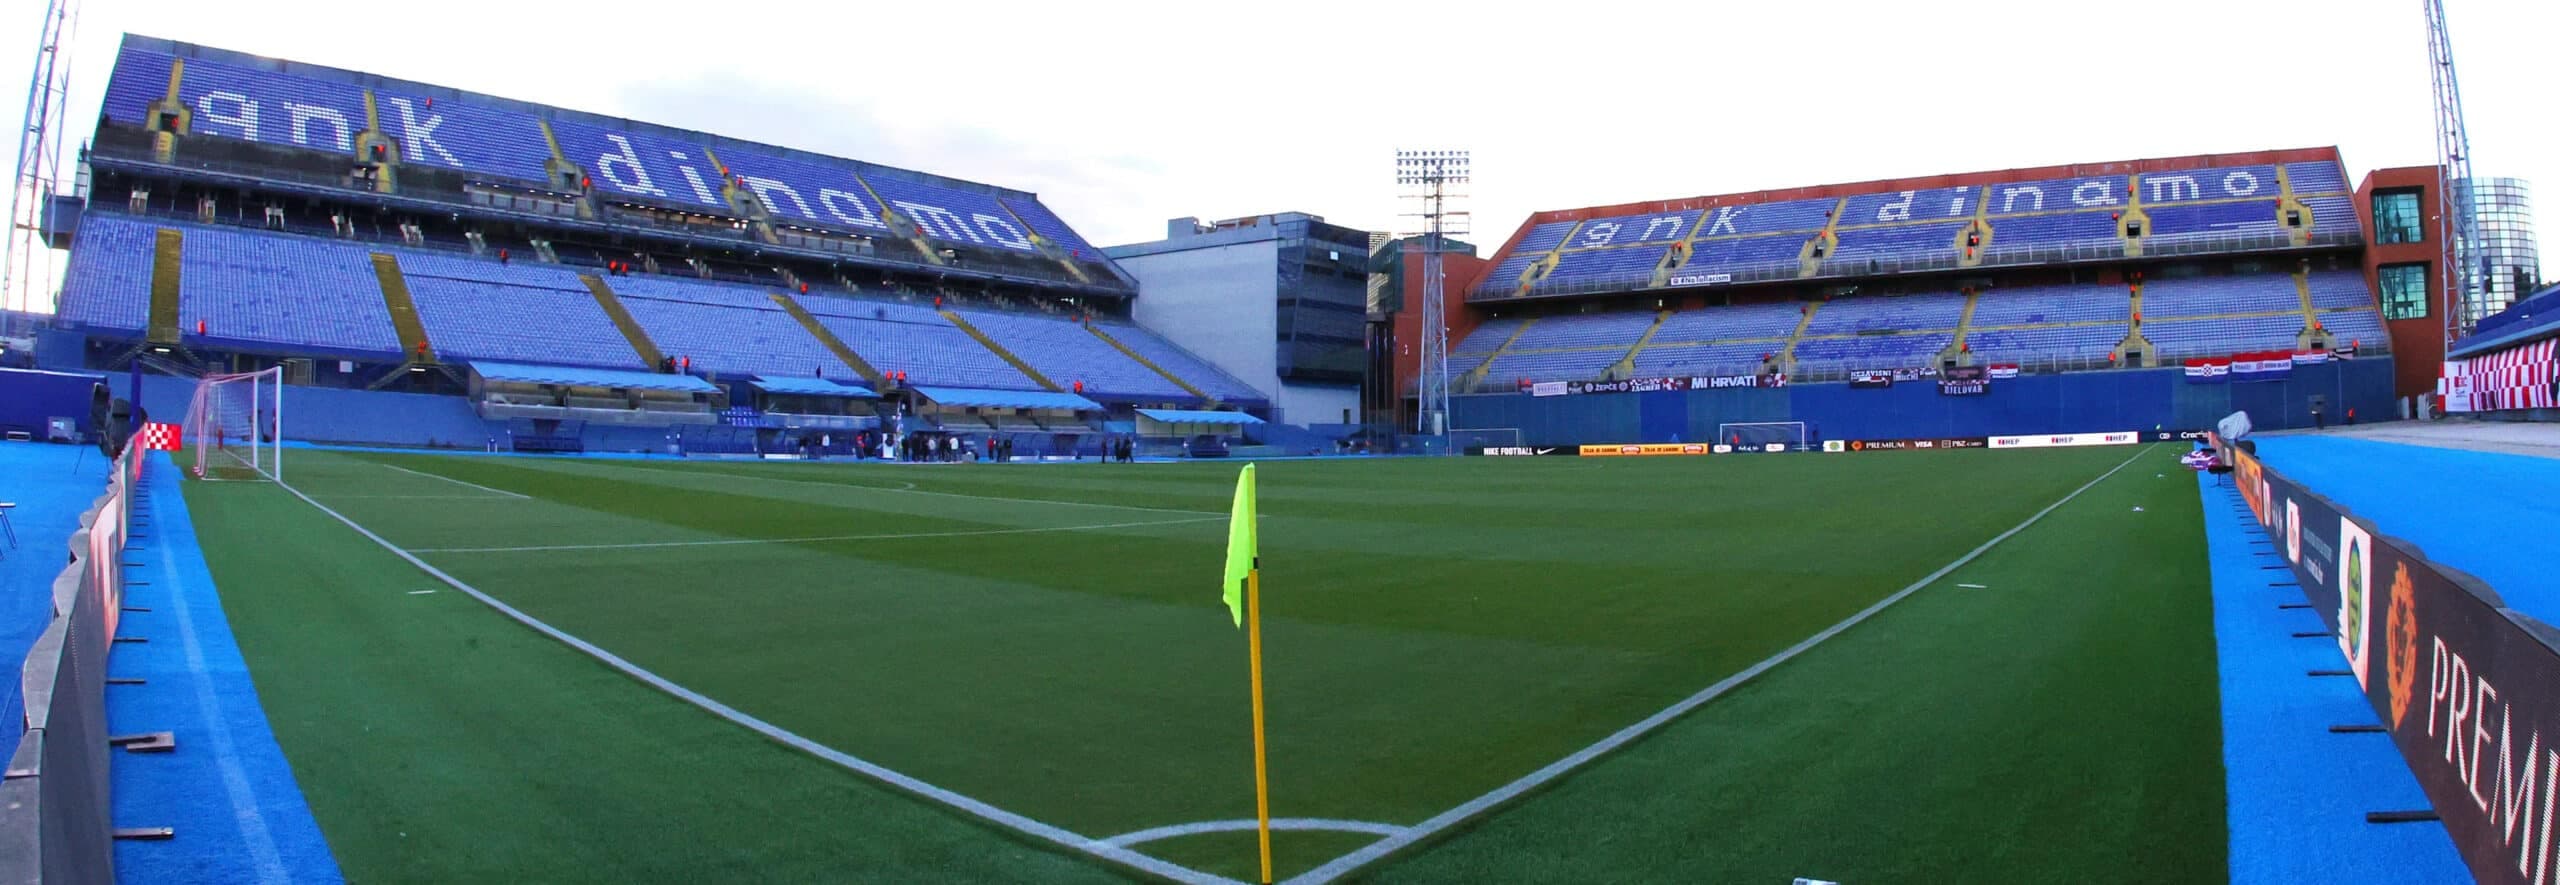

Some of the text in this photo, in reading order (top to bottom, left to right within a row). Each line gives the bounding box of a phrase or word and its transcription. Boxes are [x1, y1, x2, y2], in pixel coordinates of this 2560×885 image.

[597, 134, 1032, 251] dinamo
[1581, 171, 2259, 248] gnk dinamo
[1691, 375, 1757, 389] MI HRVATI
[1483, 447, 1533, 456] NIKE FOOTBALL
[1866, 441, 1905, 449] PREMIUM
[2428, 634, 2560, 885] PREMI
